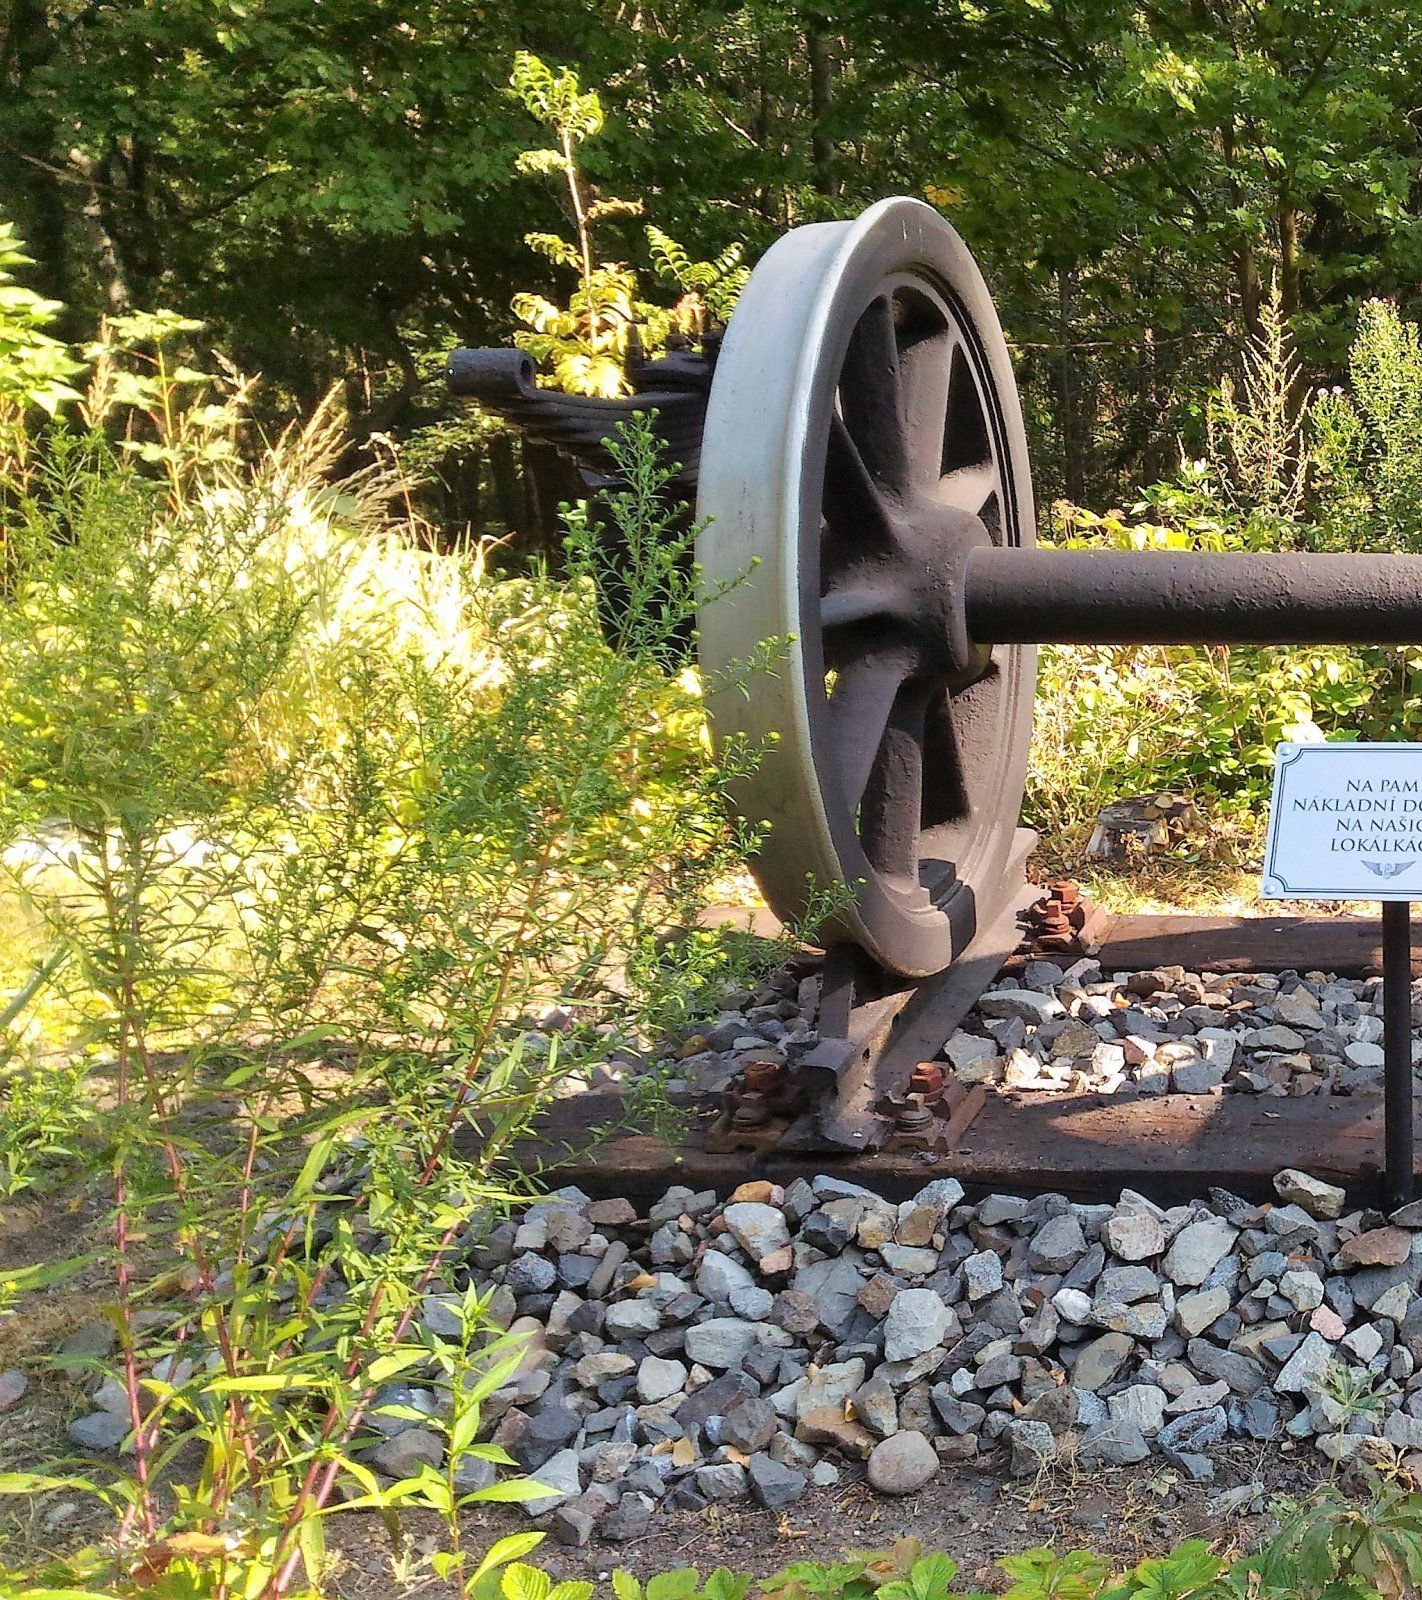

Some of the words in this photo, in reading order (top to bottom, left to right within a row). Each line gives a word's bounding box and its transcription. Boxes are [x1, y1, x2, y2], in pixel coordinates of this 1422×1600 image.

[1346, 778, 1374, 793] NA
[1292, 796, 1397, 813] NÁKLADNÍ
[1335, 817, 1364, 832] NA
